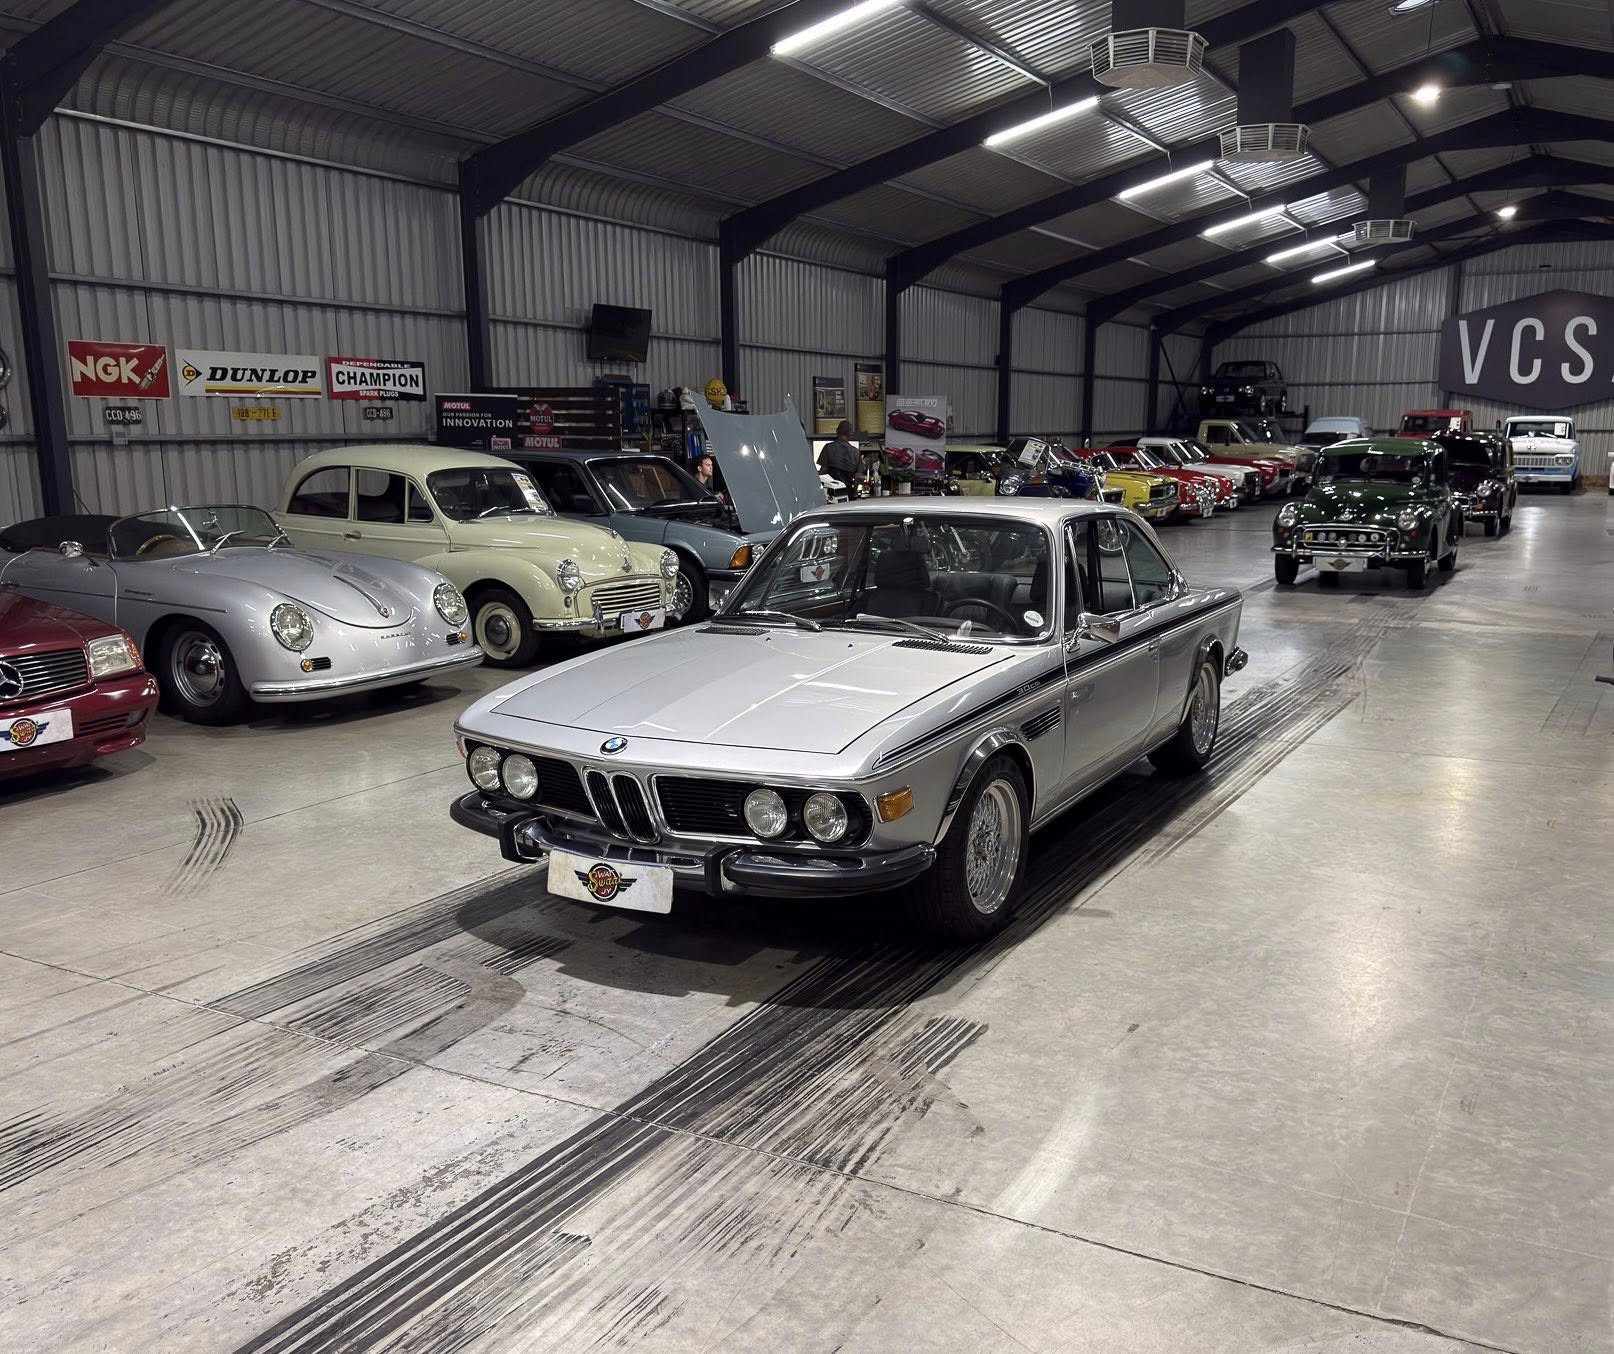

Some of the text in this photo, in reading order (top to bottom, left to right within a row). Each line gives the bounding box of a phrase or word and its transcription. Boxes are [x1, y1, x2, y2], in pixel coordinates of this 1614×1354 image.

[1458, 315, 1614, 385] VCS
[71, 355, 142, 384] NGK
[342, 360, 411, 369] DEPENDABLE
[206, 366, 317, 384] DUNLOP
[335, 370, 420, 388] CHAMPION
[379, 390, 399, 398] PLUGS
[442, 418, 513, 428] INNOVATION
[530, 415, 552, 423] MOTUL
[524, 437, 560, 448] MOTUL
